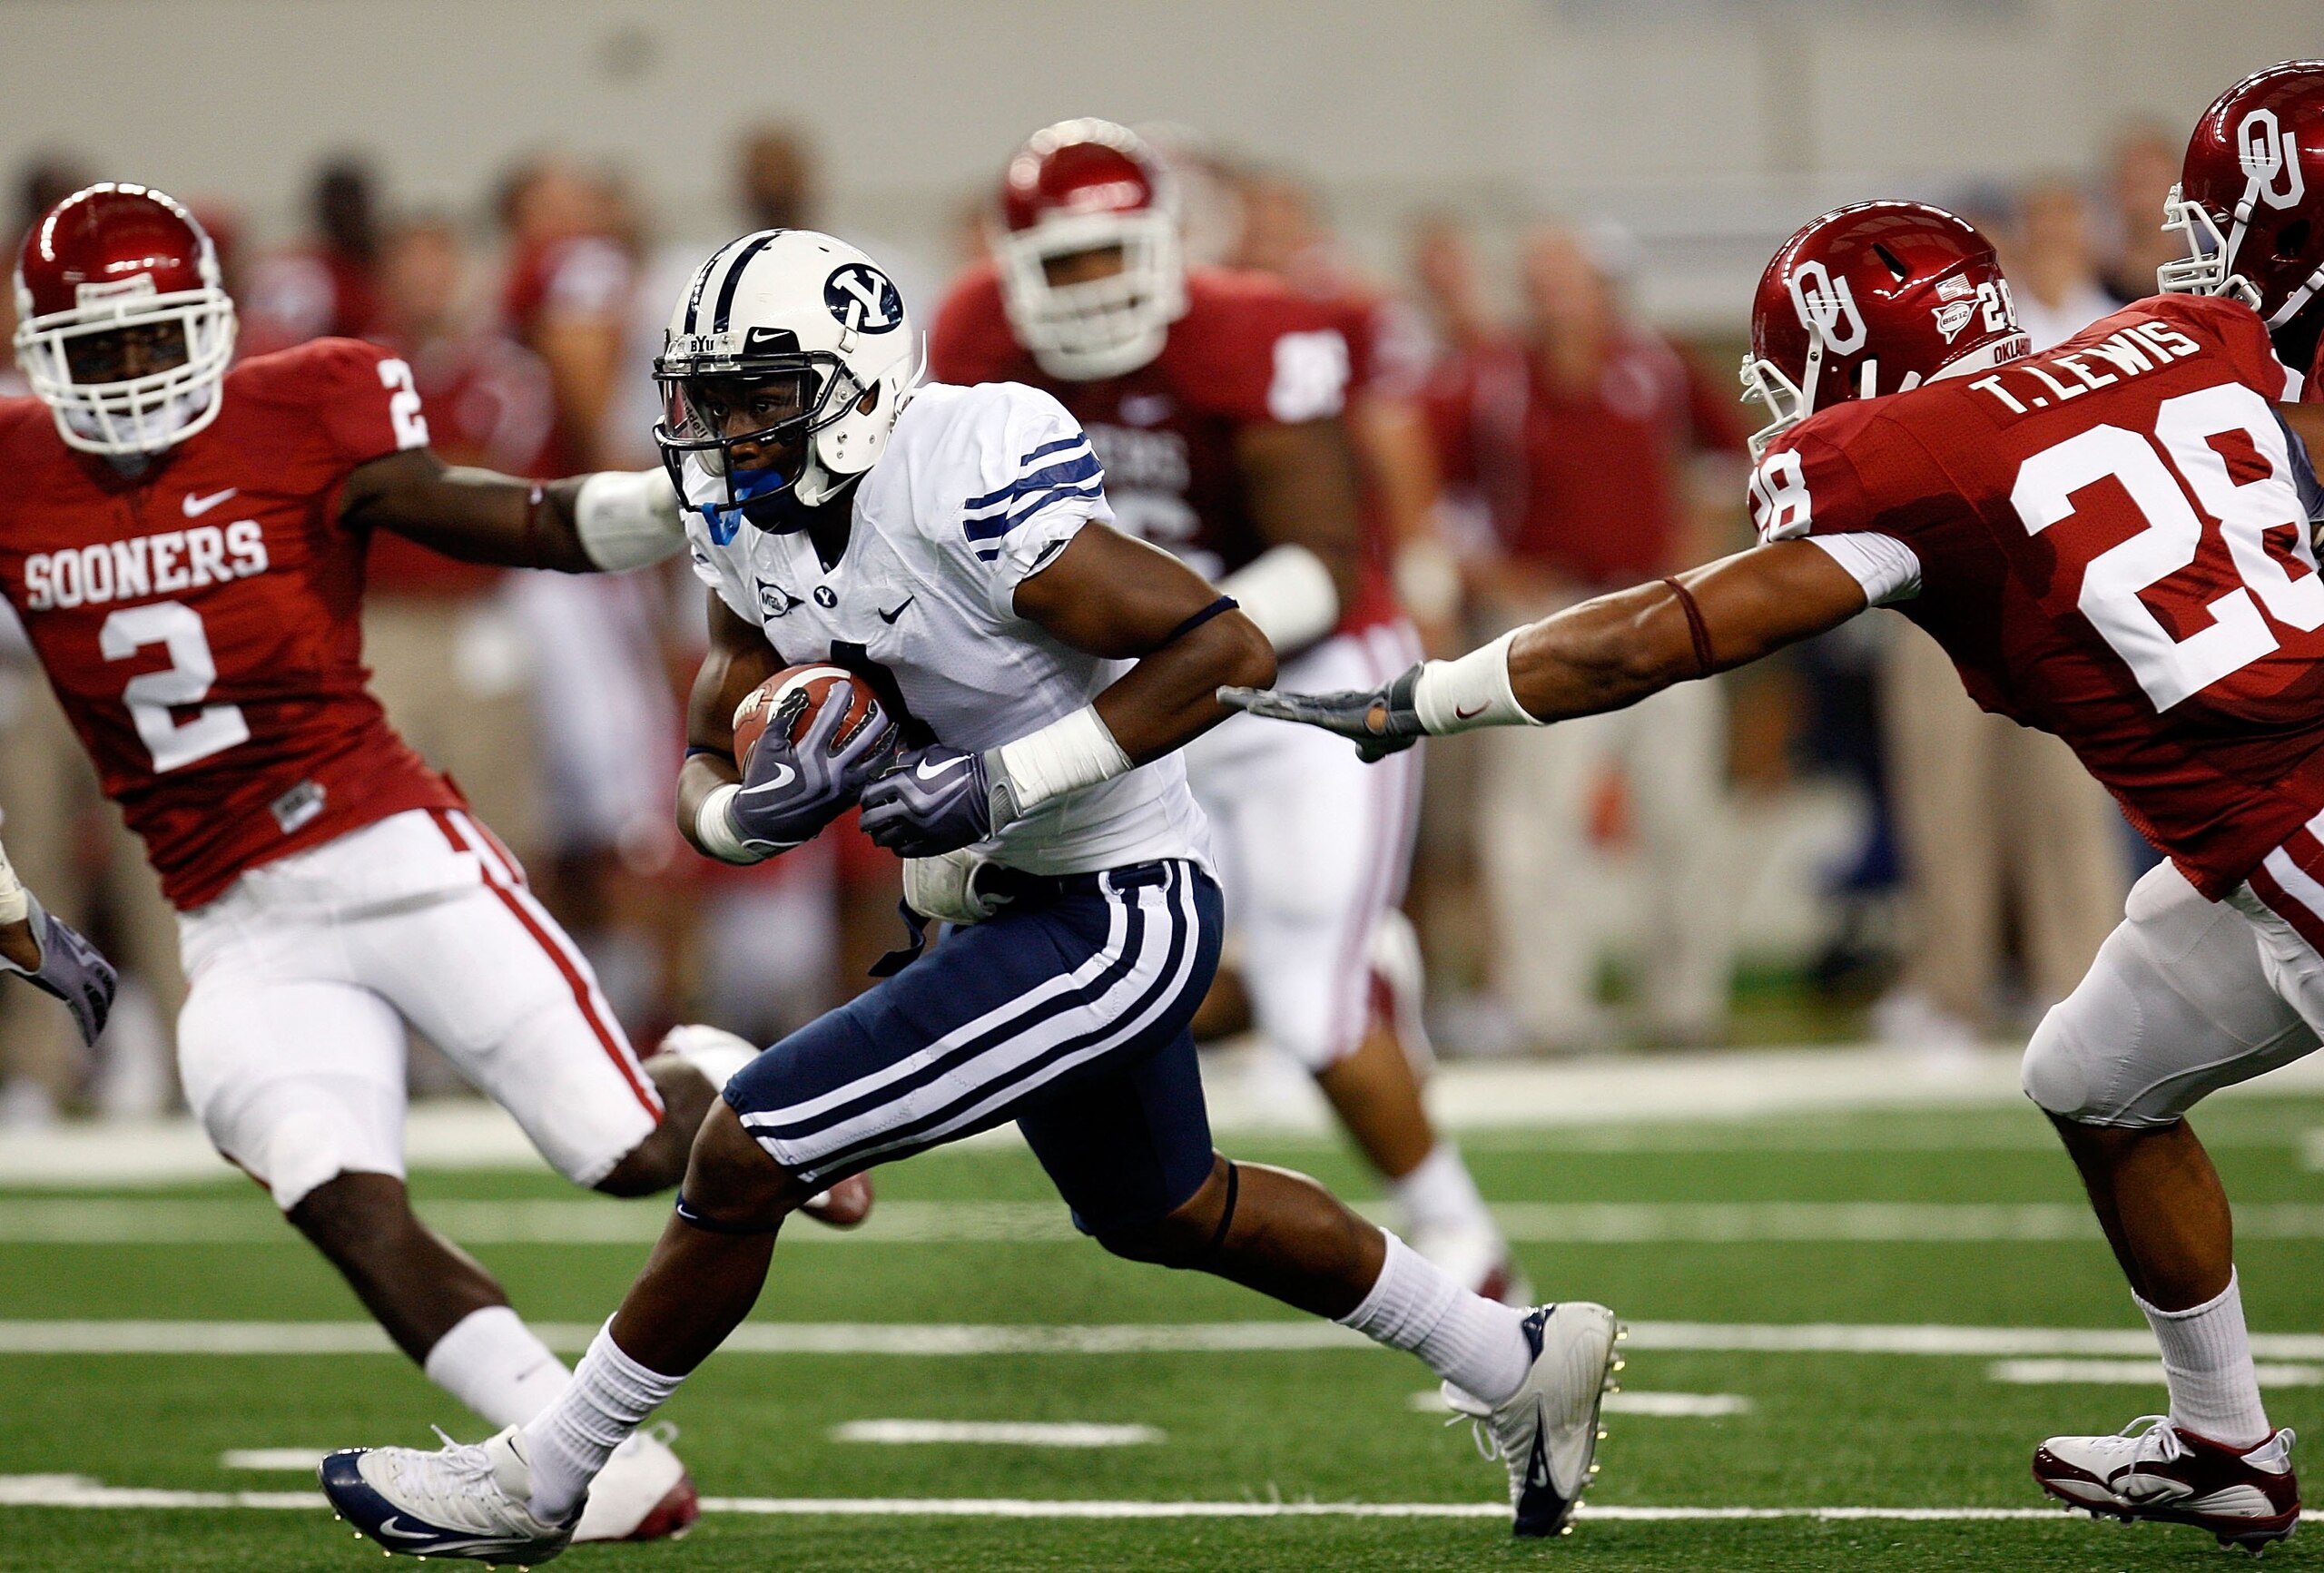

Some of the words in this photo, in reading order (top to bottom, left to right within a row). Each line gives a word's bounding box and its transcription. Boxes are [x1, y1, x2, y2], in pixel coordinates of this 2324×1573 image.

[2237, 108, 2306, 211] OU
[690, 335, 714, 352] BYU
[832, 269, 890, 327] Y
[1790, 260, 1868, 357] OU
[1942, 314, 1958, 326] BIG
[1958, 310, 1968, 321] 12
[377, 358, 430, 450] 2
[24, 518, 270, 612] SOONERS
[2009, 380, 2324, 714] 28
[98, 599, 251, 774] 2
